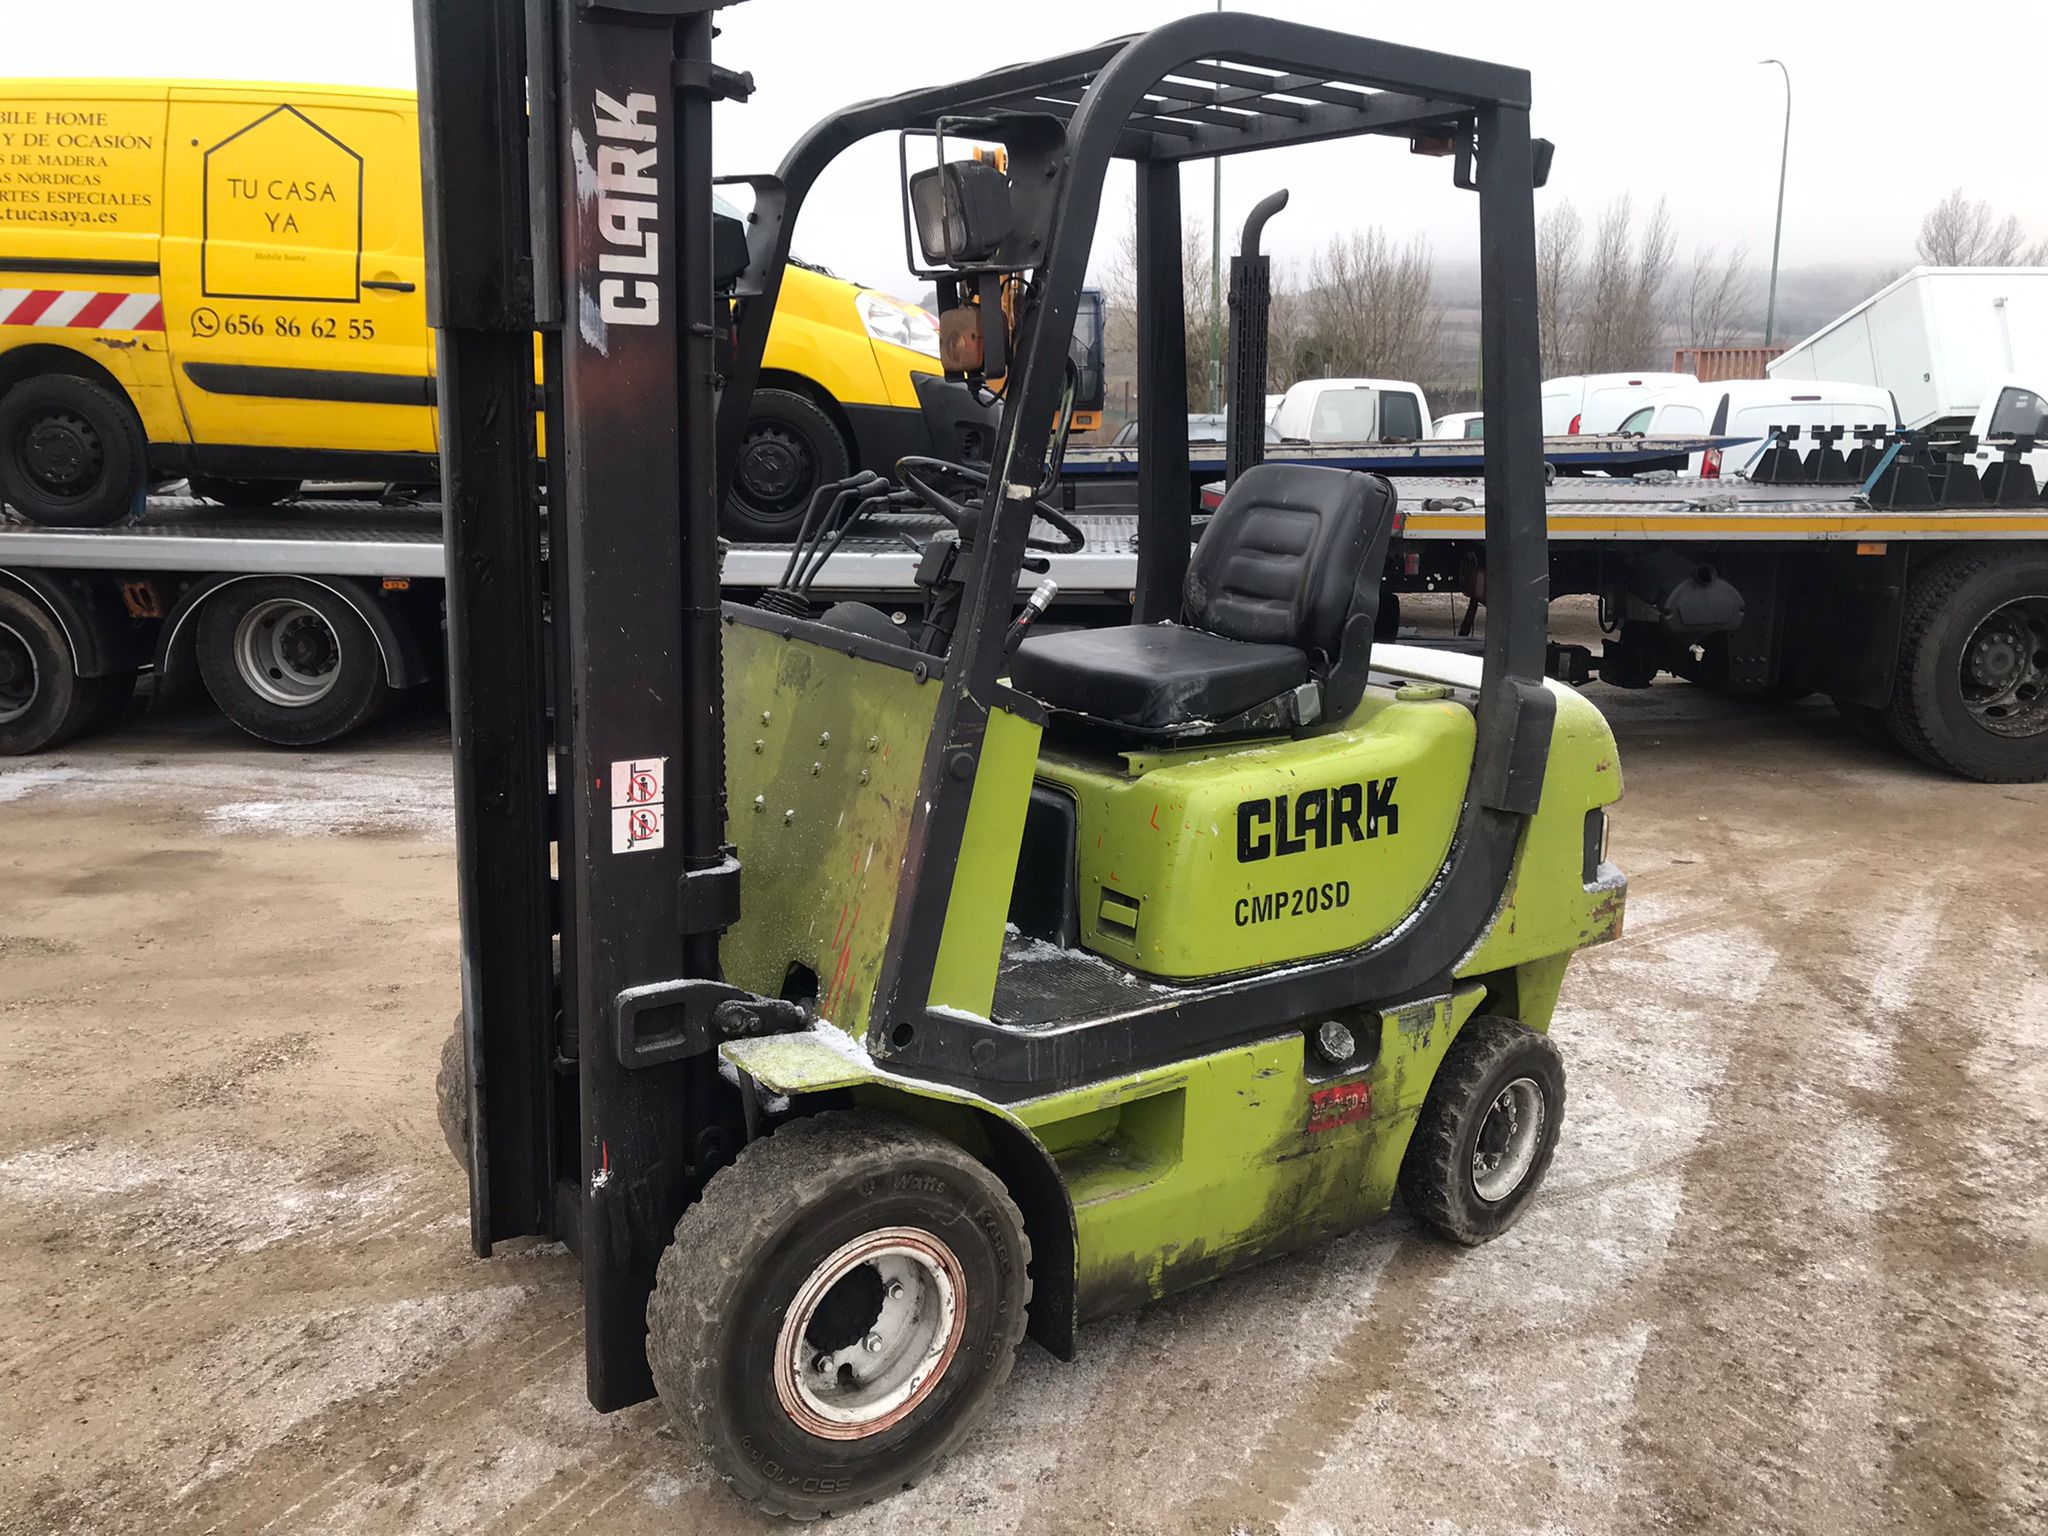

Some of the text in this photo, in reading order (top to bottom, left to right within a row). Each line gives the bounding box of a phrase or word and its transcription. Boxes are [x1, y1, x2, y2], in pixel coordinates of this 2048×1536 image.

[45, 111, 108, 126] HOME
[2, 131, 153, 149] Y DE OCASIÓN
[11, 154, 32, 165] DE
[38, 154, 108, 167] MADERA
[18, 171, 101, 185] NÓRDICAS
[47, 191, 152, 206] ESPECIALES
[227, 178, 336, 202] TU CASA
[591, 88, 660, 327] CLARK
[264, 212, 299, 233] YA
[225, 314, 375, 340] 656 86 62 55
[1236, 776, 1399, 864] CLARK
[1234, 880, 1350, 927] CMP20SD
